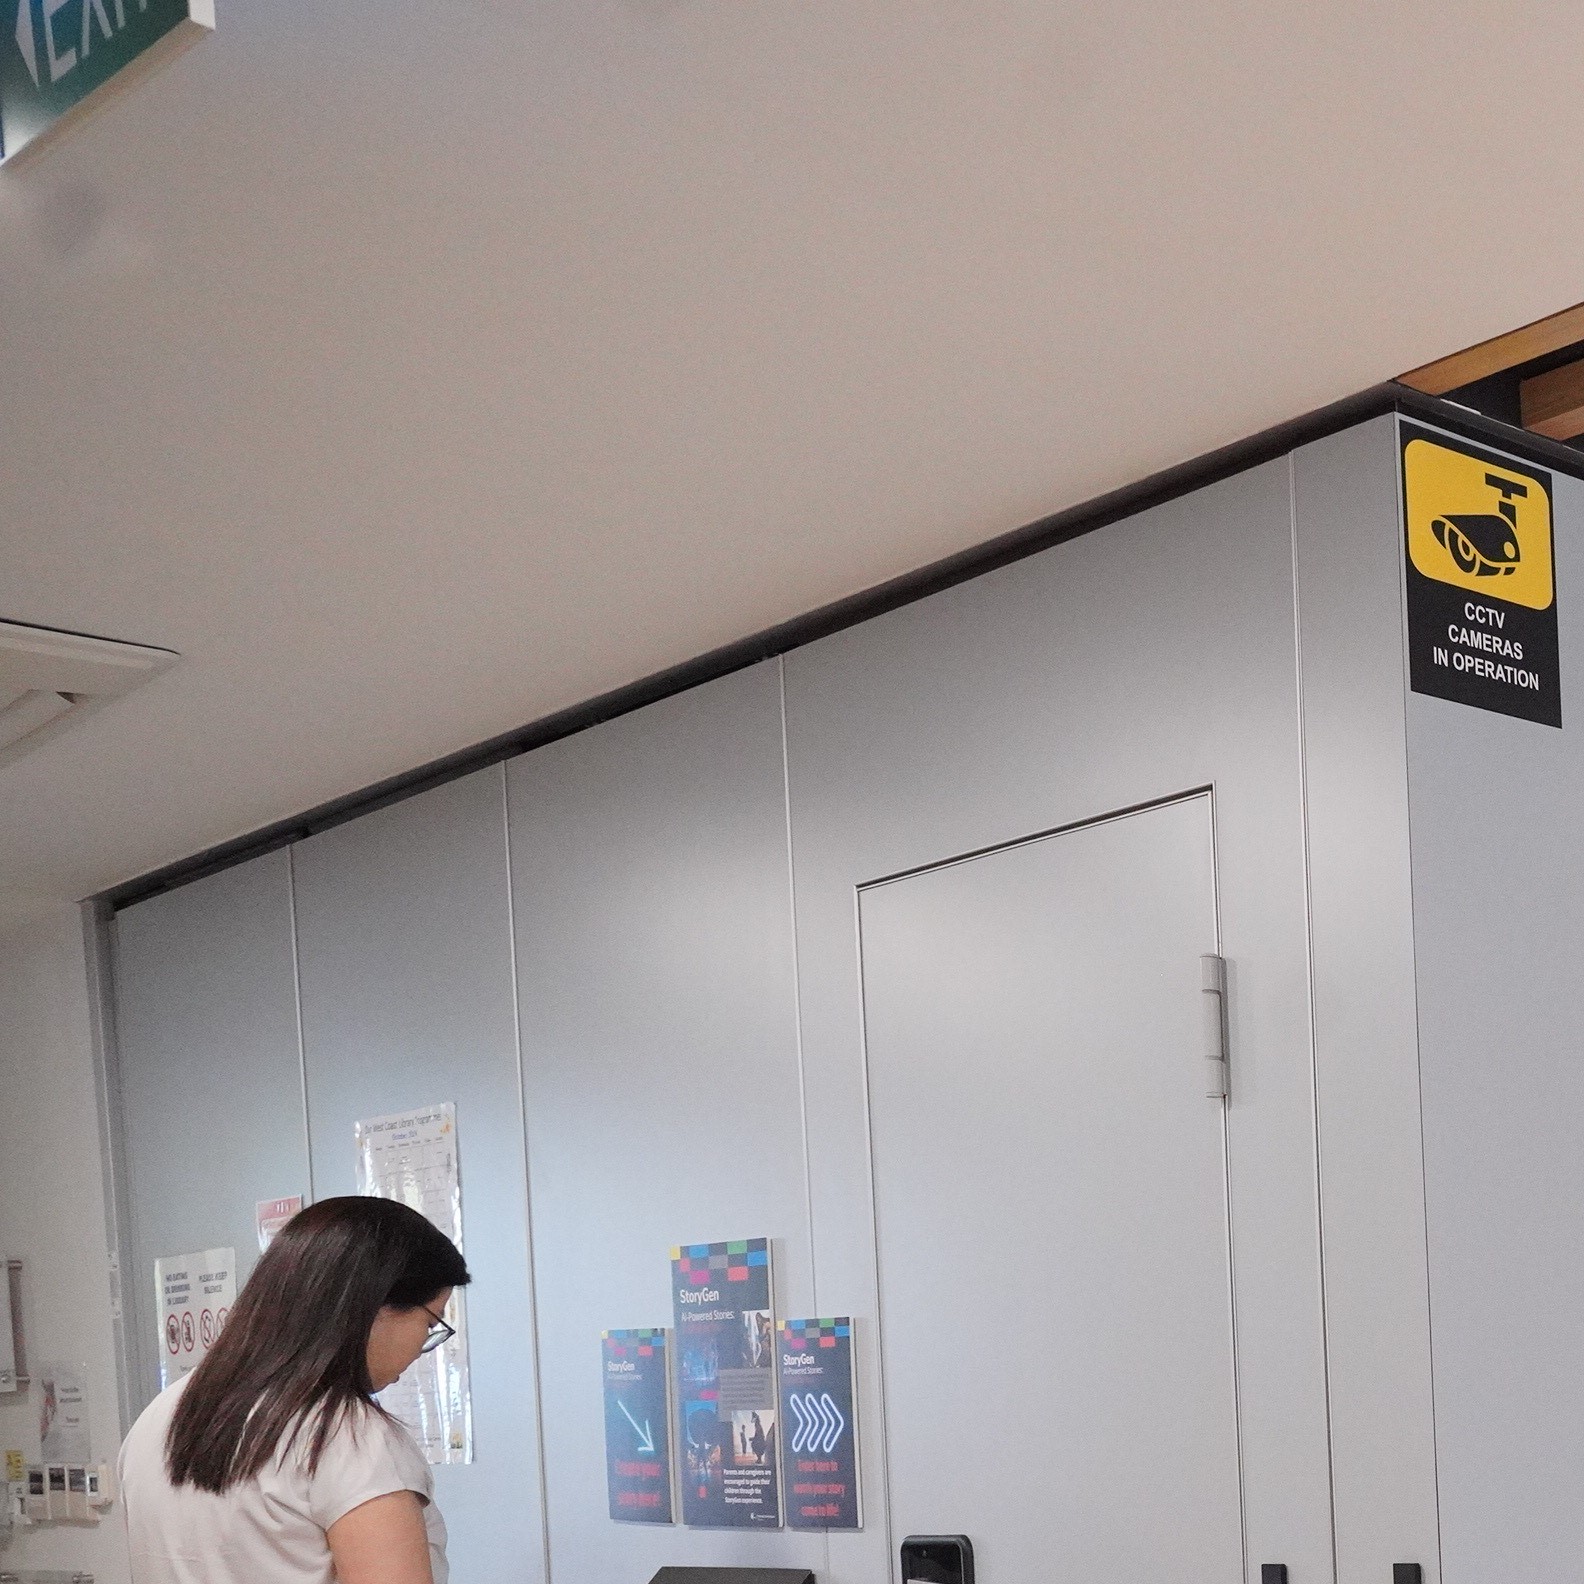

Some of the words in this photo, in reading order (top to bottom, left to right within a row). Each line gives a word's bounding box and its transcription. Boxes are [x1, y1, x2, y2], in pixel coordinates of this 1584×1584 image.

[1464, 602, 1505, 629] CCTV
[1447, 624, 1523, 660] CAMERAS
[1433, 646, 1448, 668] IN
[1452, 652, 1539, 691] OPERATION
[680, 1287, 719, 1305] StoryGen
[783, 1353, 815, 1367] StoryGen
